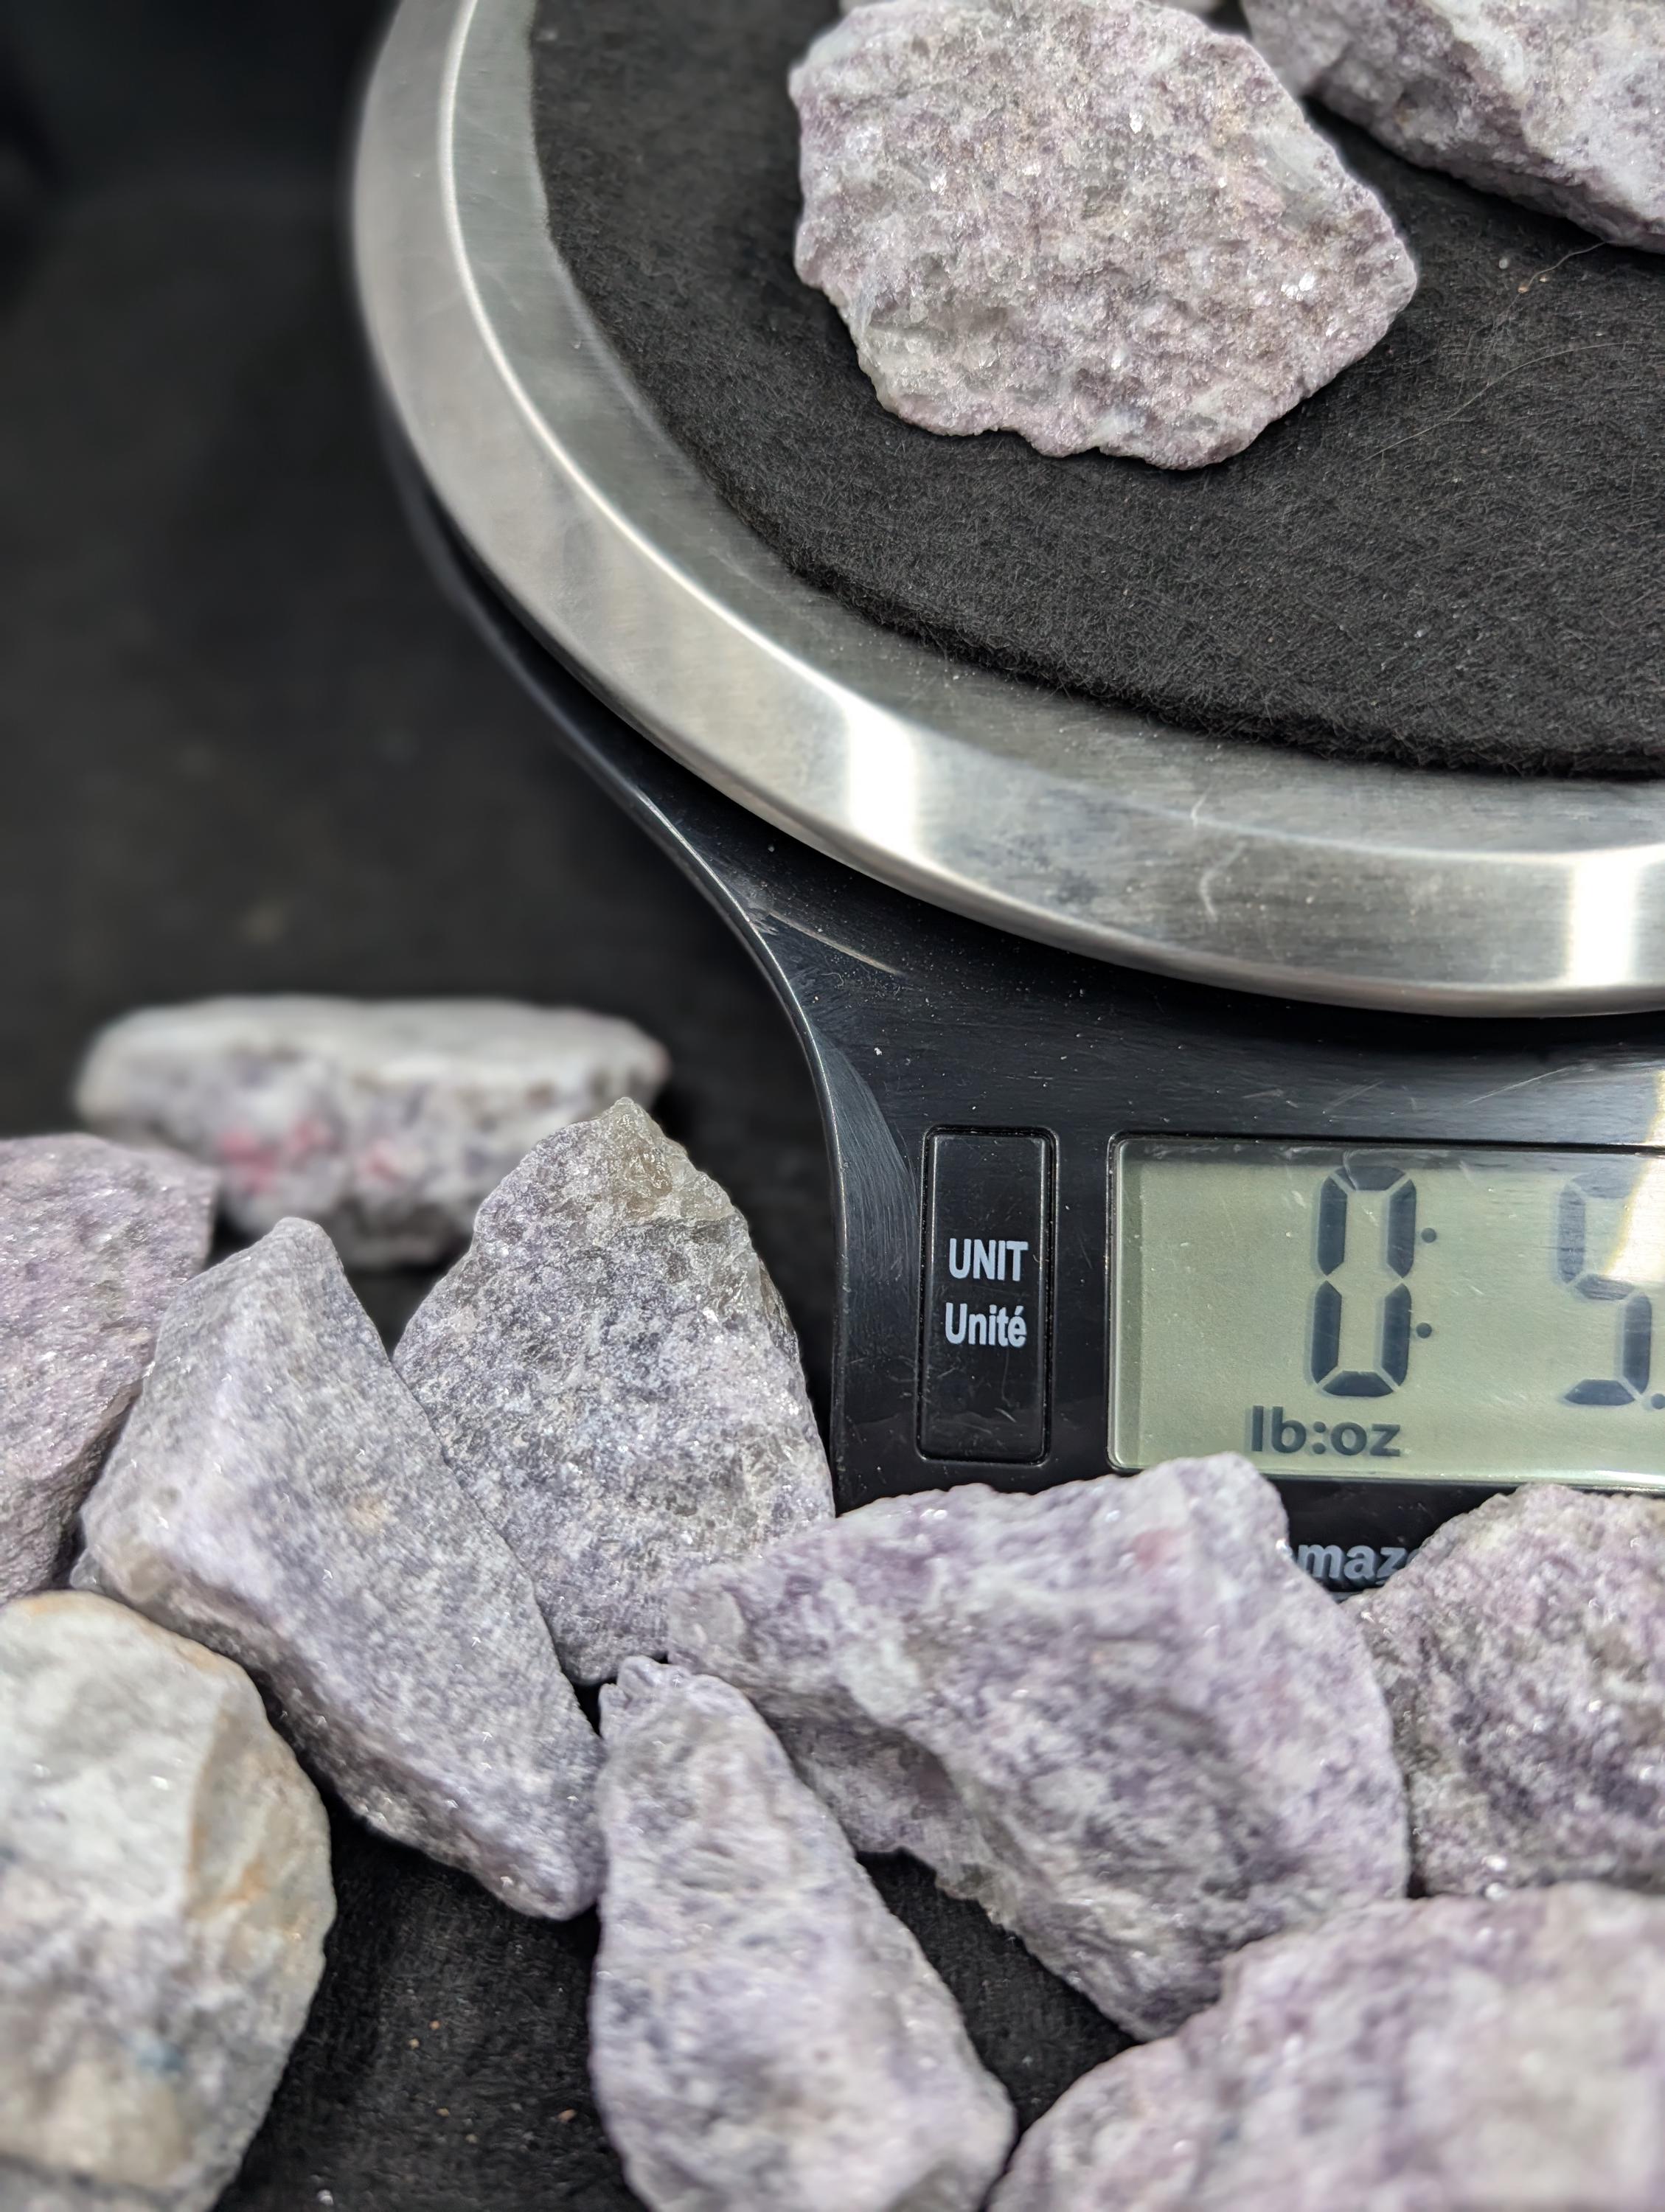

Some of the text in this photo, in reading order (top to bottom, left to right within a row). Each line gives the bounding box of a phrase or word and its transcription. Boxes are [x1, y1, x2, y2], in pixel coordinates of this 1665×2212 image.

[948, 1238, 1029, 1281] UNIT
[945, 1302, 1027, 1347] Unité
[1251, 1405, 1401, 1457] lb:oz
[1296, 1544, 1419, 1580] maz
